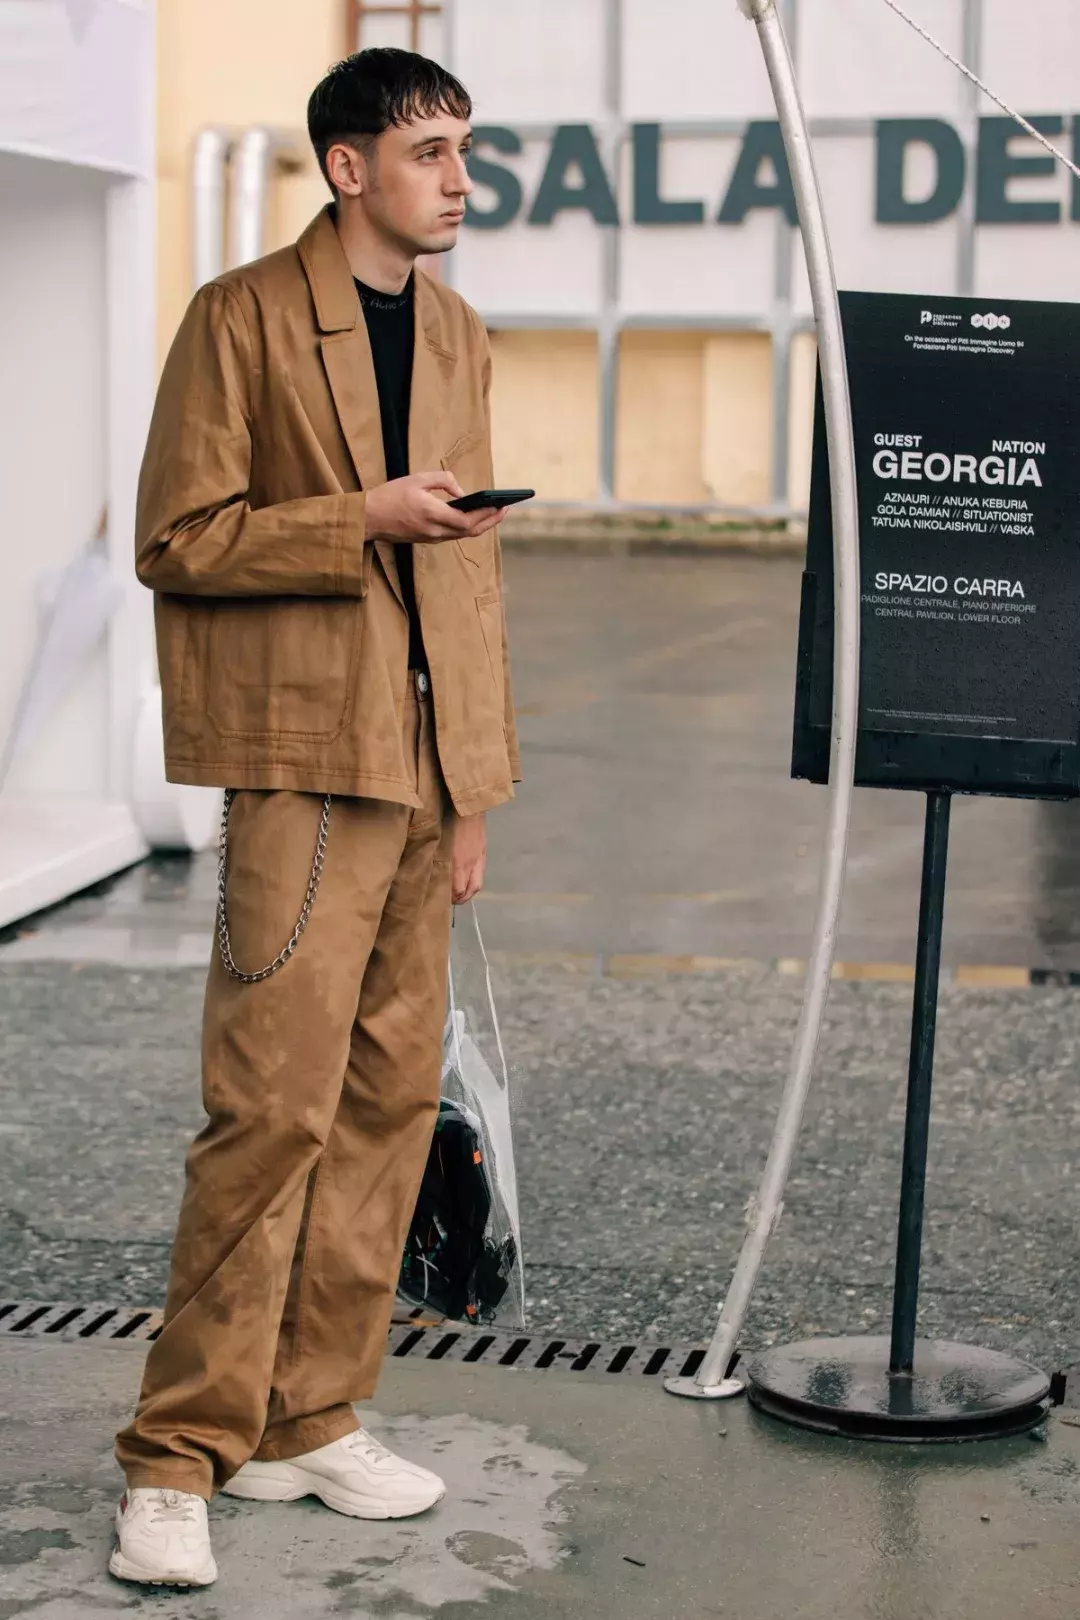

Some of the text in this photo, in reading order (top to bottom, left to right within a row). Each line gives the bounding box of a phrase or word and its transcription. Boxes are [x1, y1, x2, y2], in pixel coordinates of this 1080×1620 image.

[464, 116, 1080, 229] SALA DE
[958, 346, 986, 354] Immagine
[987, 347, 1015, 355] Discovery
[874, 433, 1046, 454] GUEST NATION
[872, 450, 1043, 487] GEORGIA
[884, 492, 930, 504] AZNAURI
[942, 496, 980, 507] ANUKA
[982, 498, 1028, 510] KEBURIA
[877, 505, 906, 516] GOLA
[908, 507, 950, 518] DAMIAN
[963, 510, 1033, 522] SITUATIONIST
[872, 516, 911, 528] TATUNA
[914, 520, 987, 533] NIKOLAISHVILI
[1000, 524, 1034, 536] VASKA
[874, 572, 1025, 598] SPAZIO CARRA
[861, 594, 912, 606] PADIGLIONE
[962, 601, 990, 610] PIANO
[992, 602, 1036, 613] INFERIORE
[875, 608, 914, 618] CENTRAL
[958, 613, 990, 622] LOWER
[992, 615, 1021, 625] FLOOR
